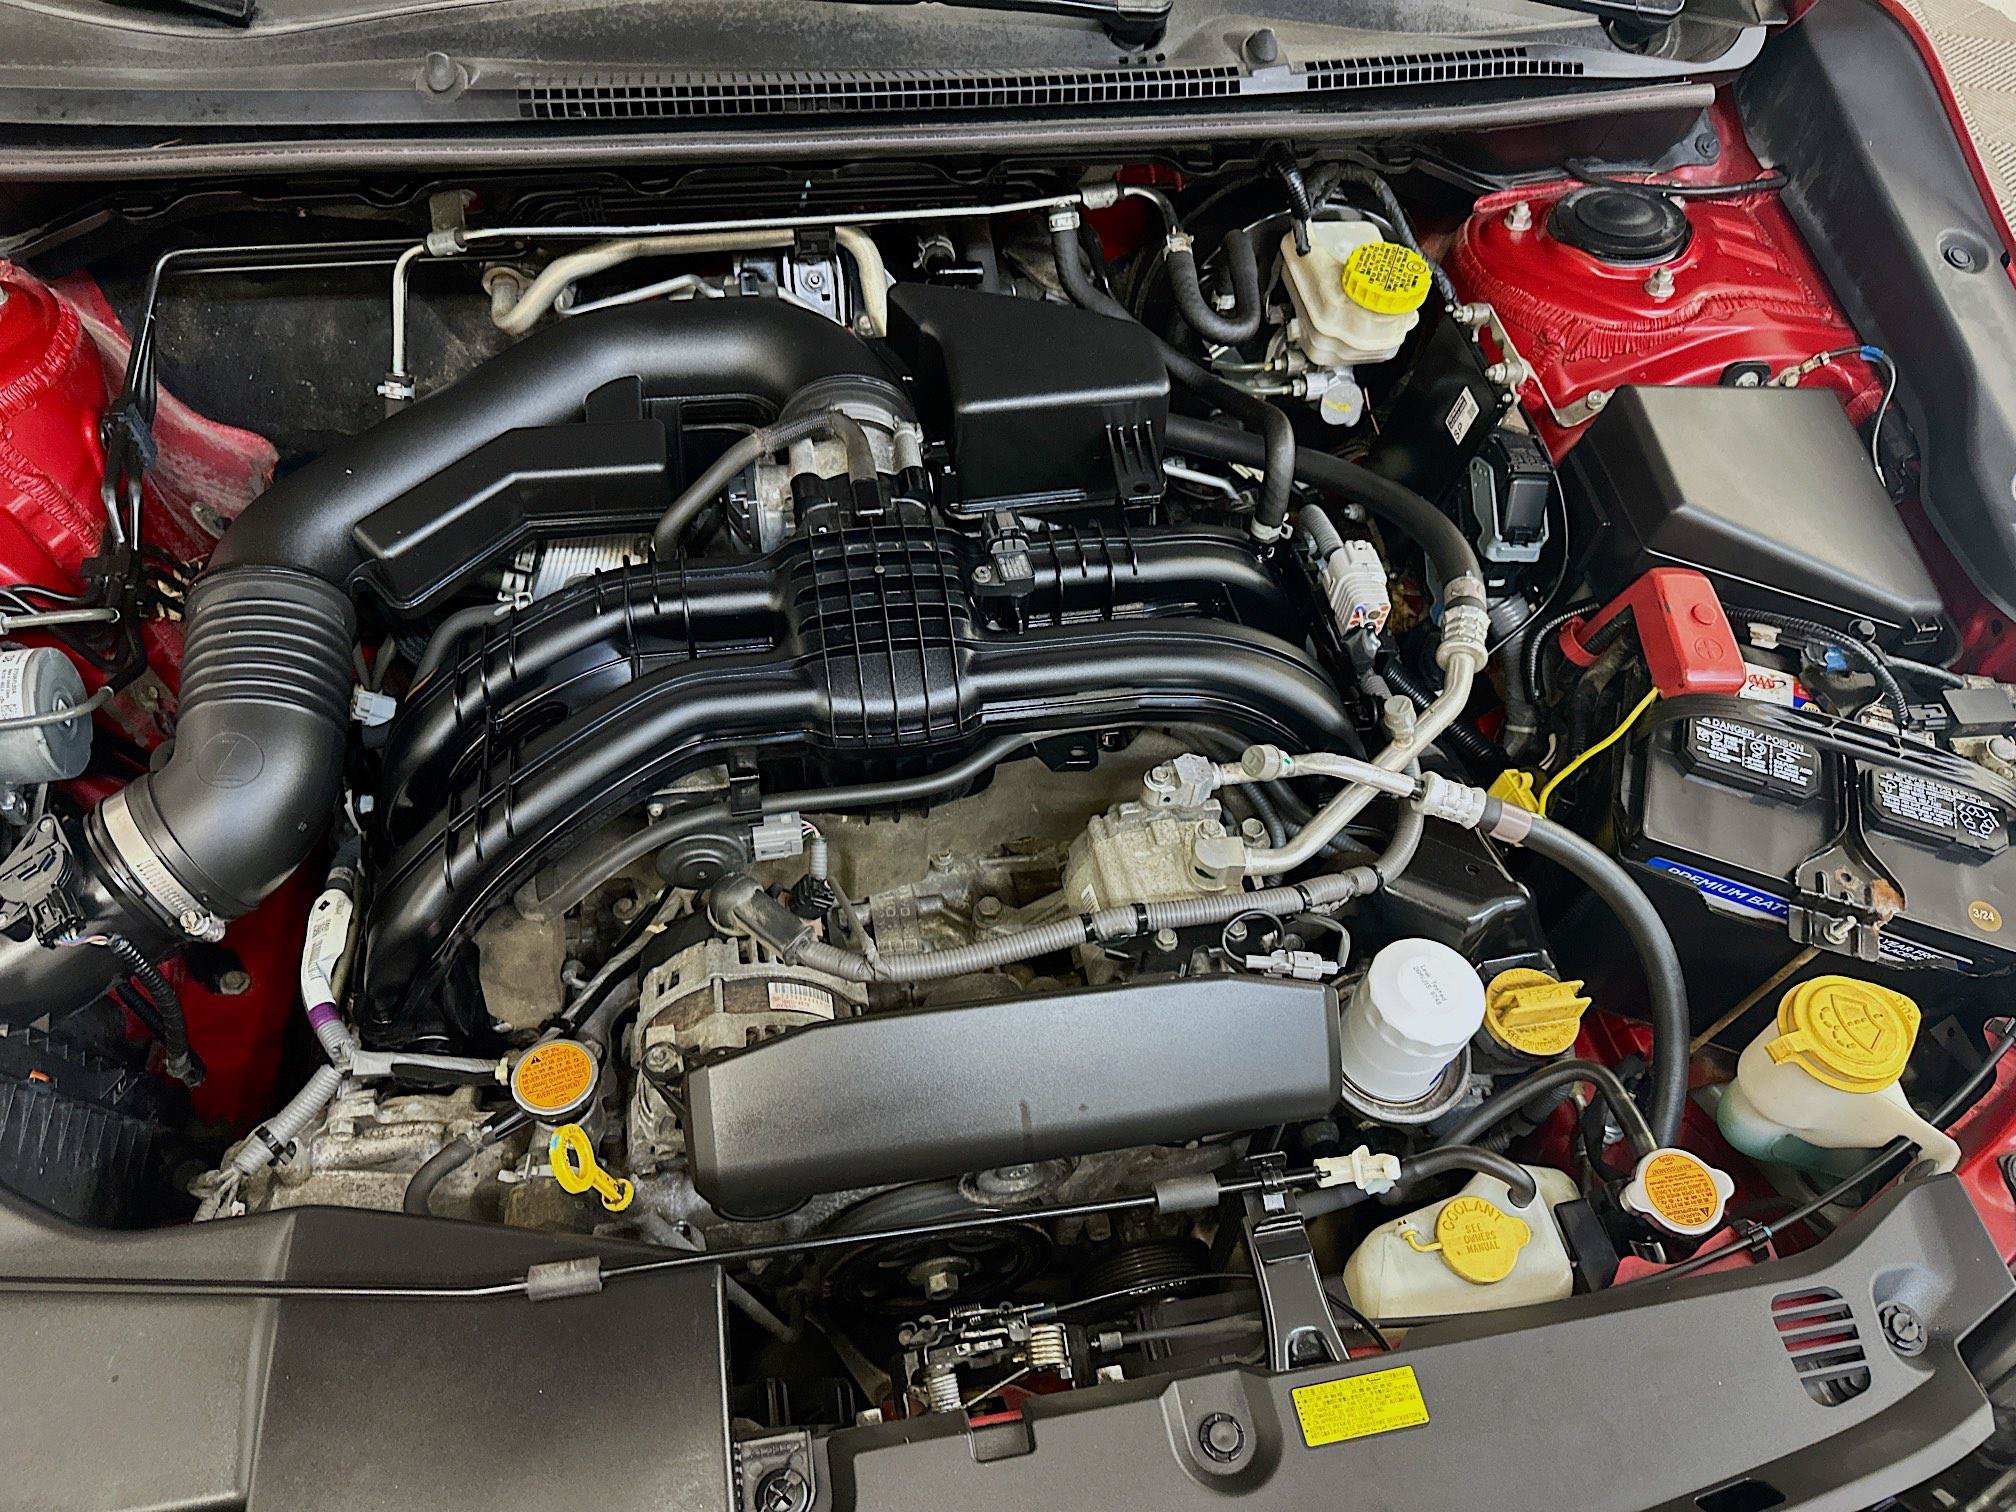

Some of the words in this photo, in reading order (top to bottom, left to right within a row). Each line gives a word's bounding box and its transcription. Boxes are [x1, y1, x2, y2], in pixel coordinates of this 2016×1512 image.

[1749, 674, 1775, 689] AAA
[1712, 718, 1755, 738] DANGER
[1766, 734, 1804, 752] POISON
[1973, 908, 1994, 922] 3/24
[1882, 938, 1915, 953] YEAR
[1442, 1200, 1504, 1231] COOLANT
[1465, 1223, 1482, 1234] SEE
[1464, 1231, 1497, 1244] OWNERS
[1466, 1241, 1500, 1254] MANUAL
